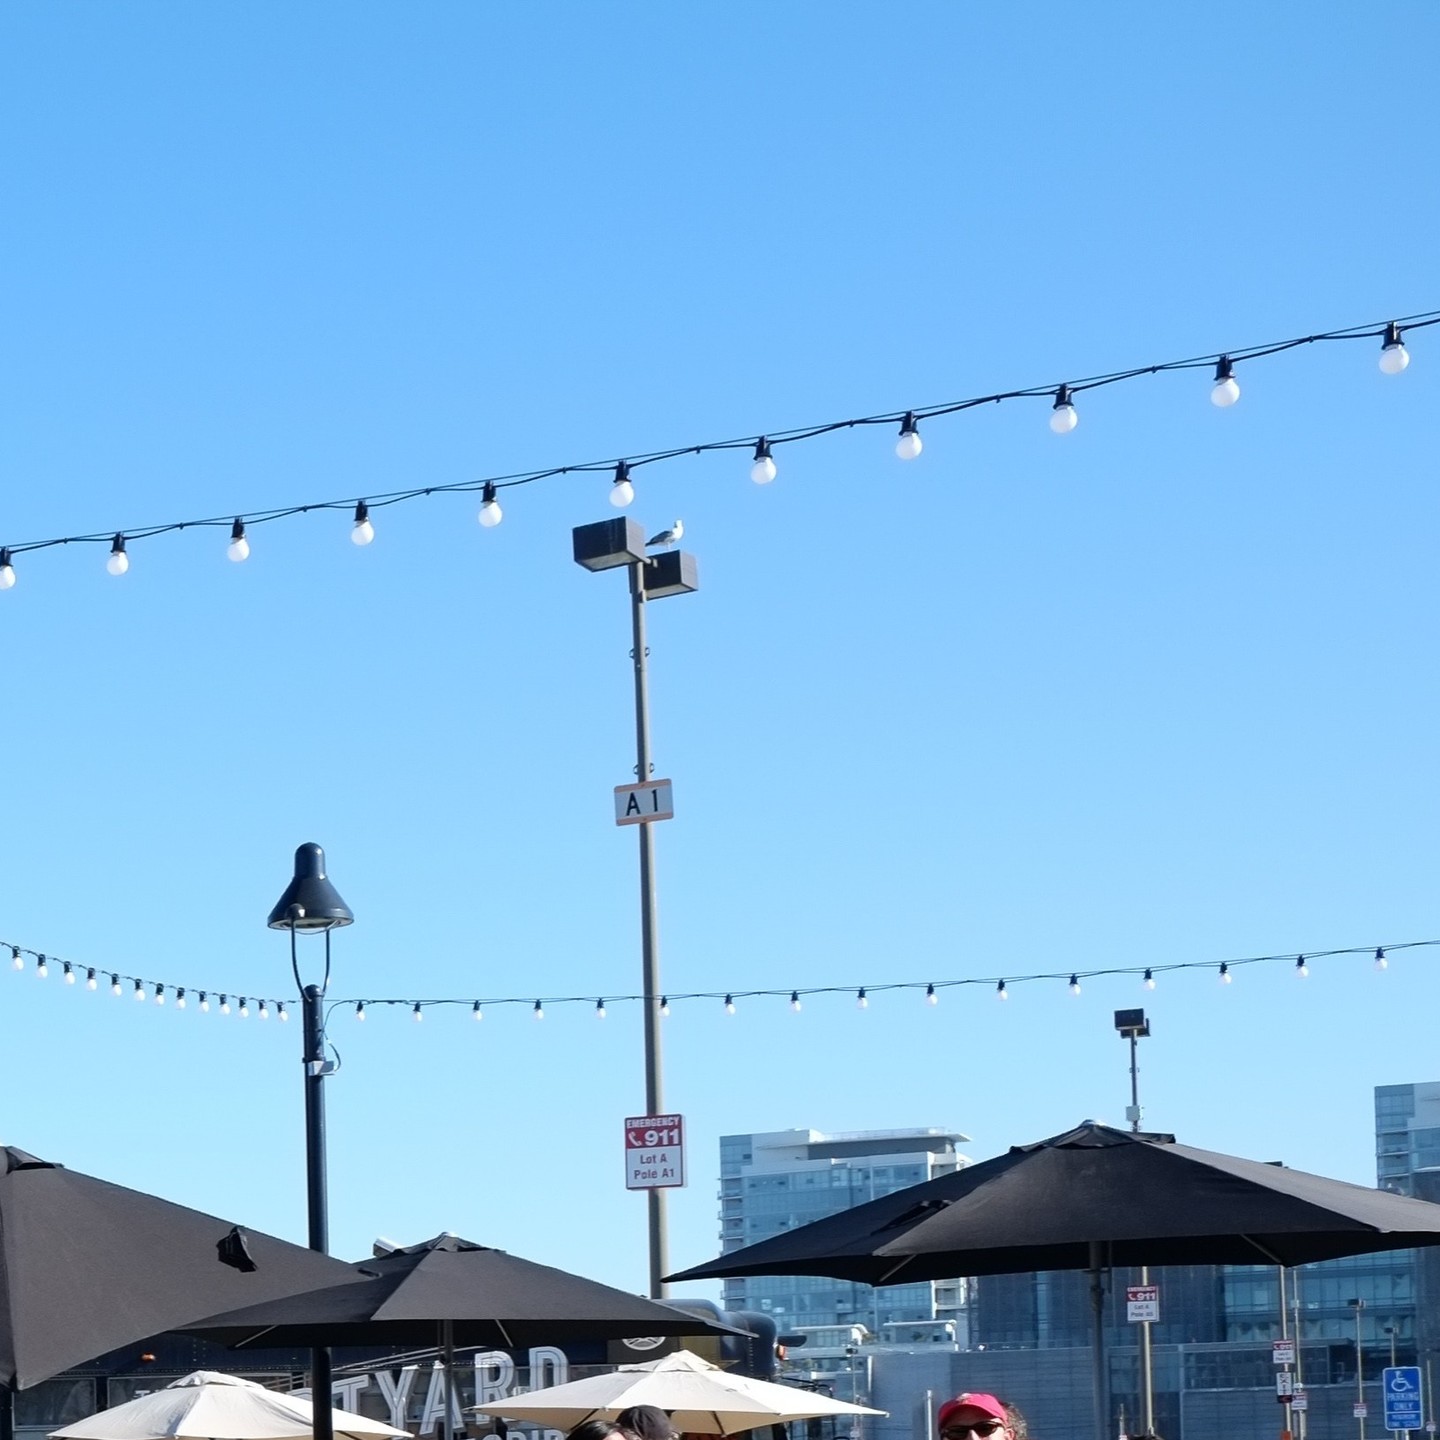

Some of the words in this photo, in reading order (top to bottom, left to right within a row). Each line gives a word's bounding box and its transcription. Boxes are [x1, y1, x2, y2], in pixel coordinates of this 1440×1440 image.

[626, 1117, 679, 1129] EMERGENCY
[644, 1129, 680, 1147] 911
[640, 1154, 656, 1164] Lot
[660, 1153, 668, 1163] A
[634, 1169, 657, 1179] Pole
[662, 1168, 674, 1178] A1
